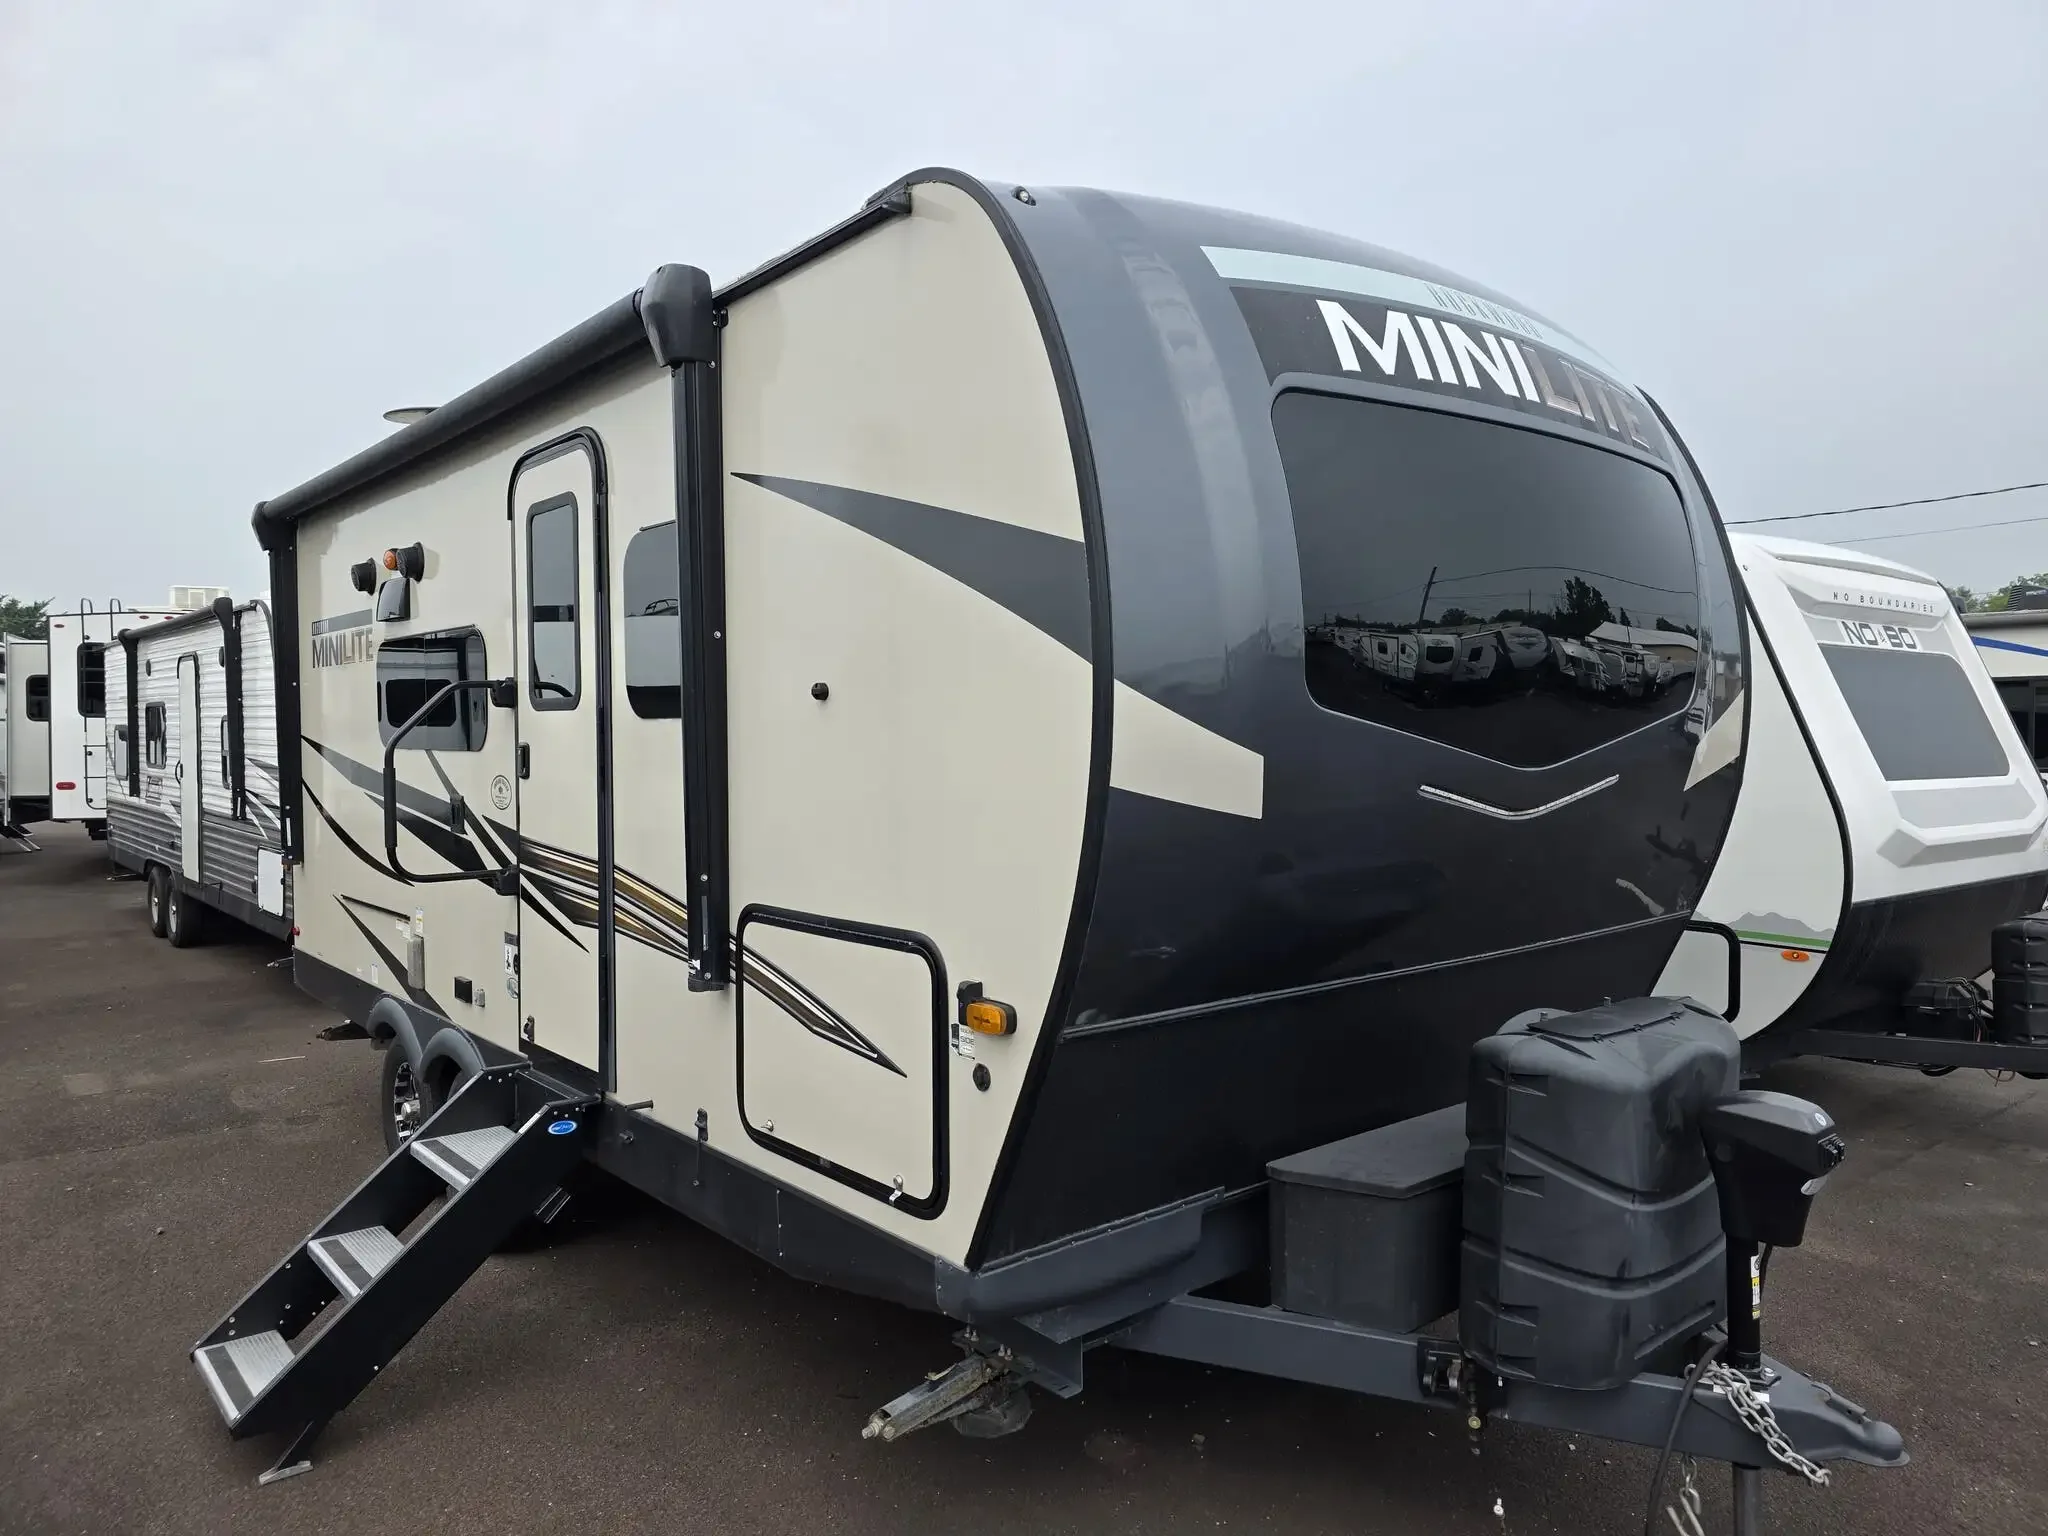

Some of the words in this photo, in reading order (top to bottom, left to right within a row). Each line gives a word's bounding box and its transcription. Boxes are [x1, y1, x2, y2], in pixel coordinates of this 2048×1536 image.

[1833, 591, 1849, 602] NO
[1859, 595, 1934, 613] BOUNDARIES
[312, 627, 374, 669] MINILITE
